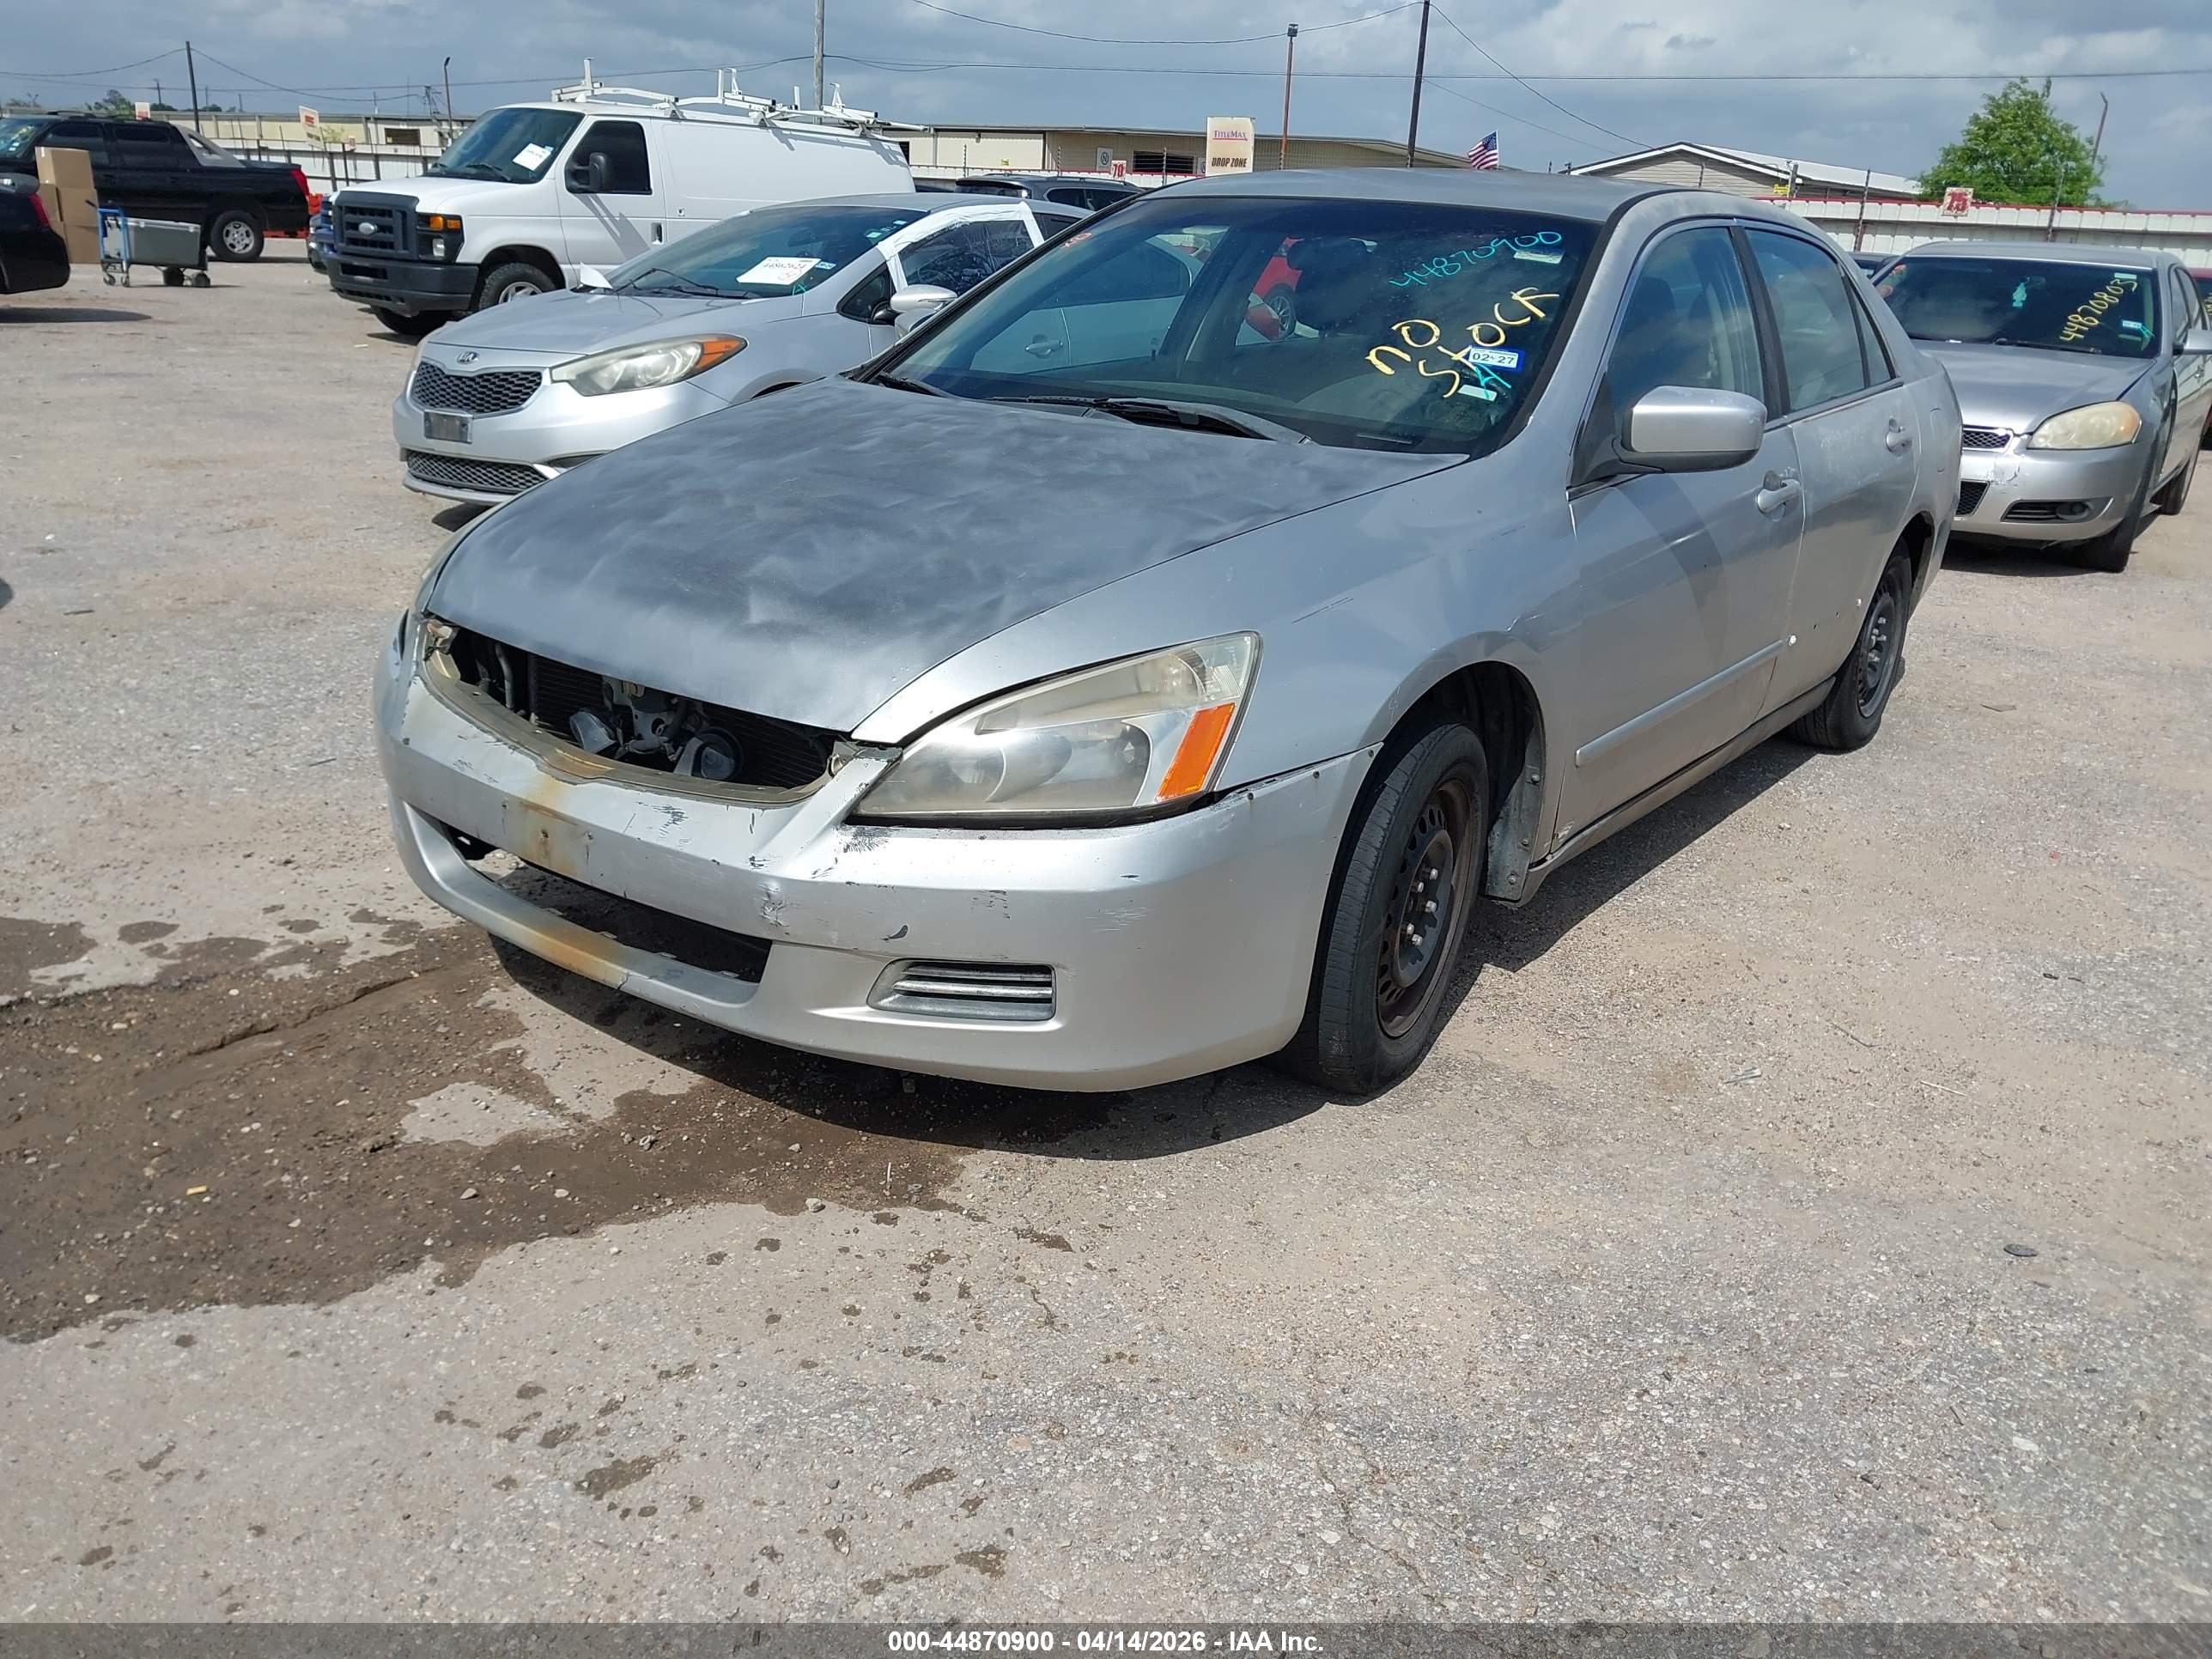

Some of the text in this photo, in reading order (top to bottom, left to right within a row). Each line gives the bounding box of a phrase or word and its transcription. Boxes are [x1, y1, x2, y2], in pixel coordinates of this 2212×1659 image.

[1212, 157, 1230, 167] DROP
[1231, 157, 1247, 167] ZONE
[1113, 164, 1123, 178] 70
[1389, 231, 1562, 287] 44870900
